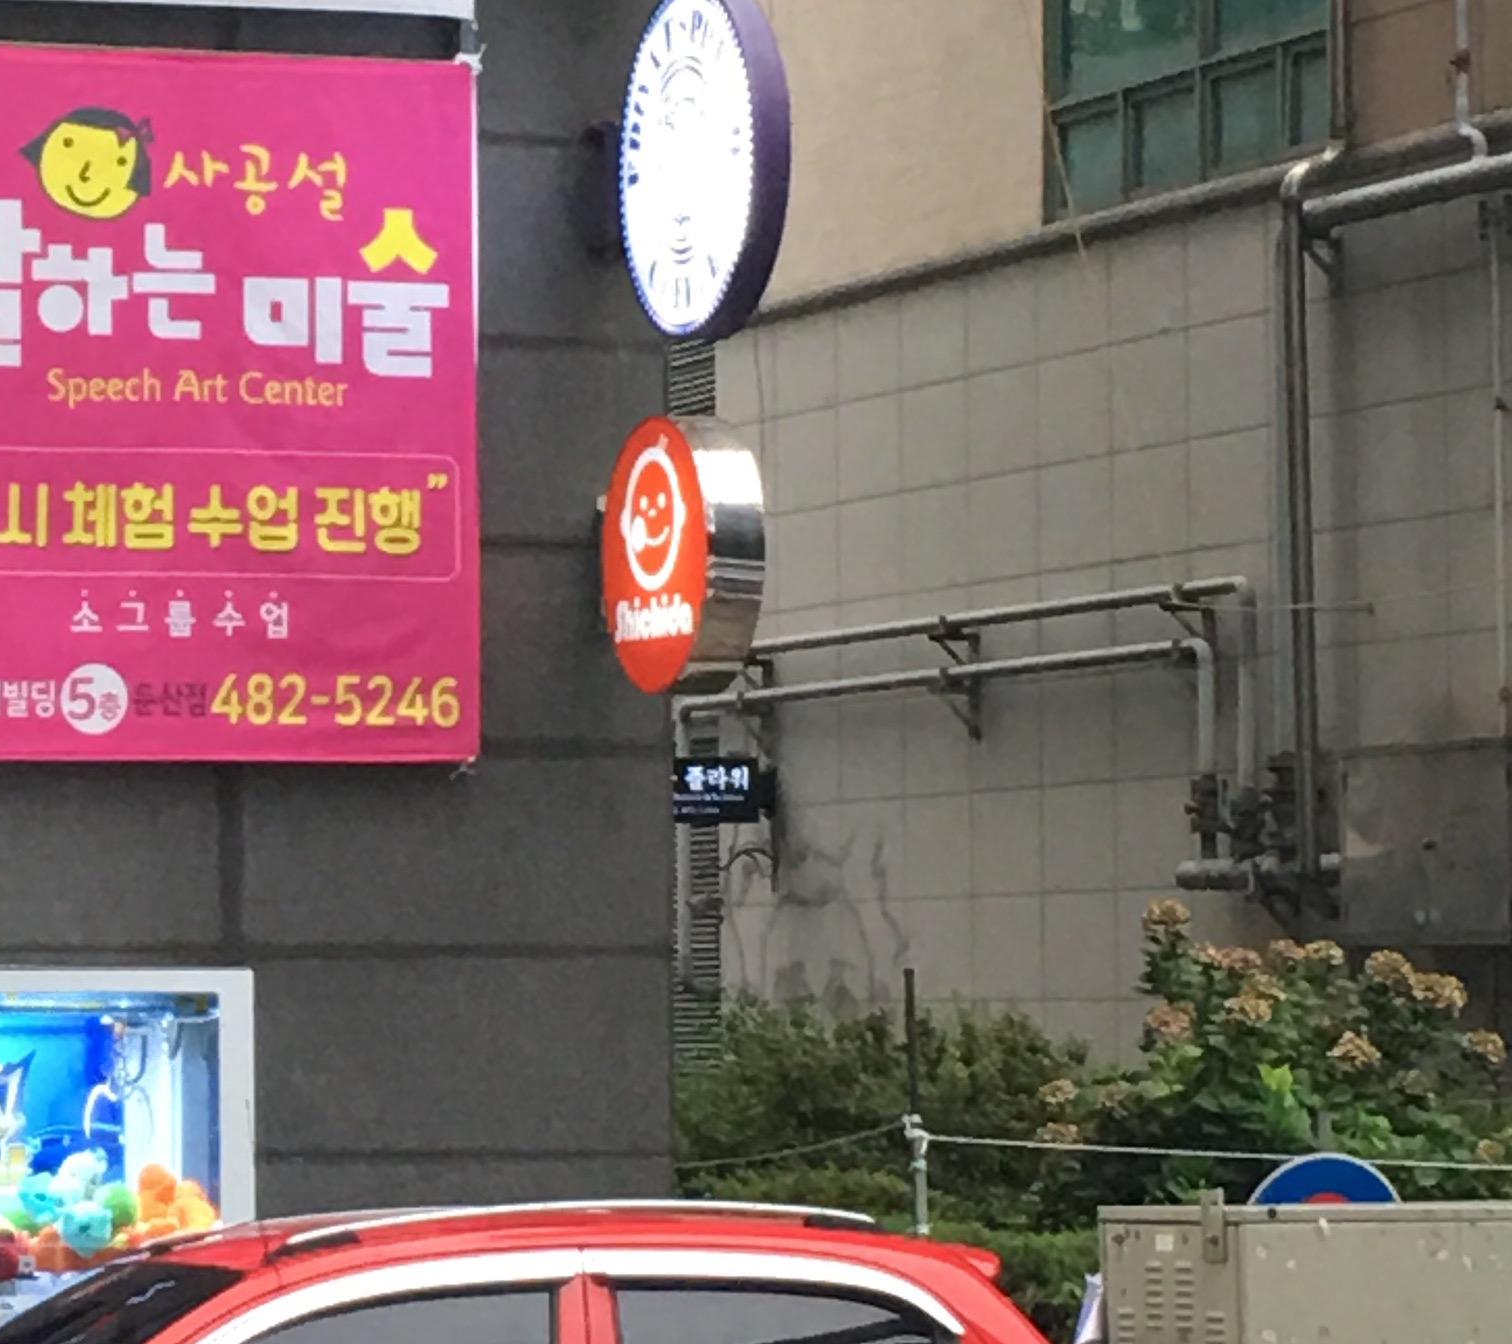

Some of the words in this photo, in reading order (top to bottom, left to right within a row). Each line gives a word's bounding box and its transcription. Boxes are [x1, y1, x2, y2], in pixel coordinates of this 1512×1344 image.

[163, 143, 347, 221] 사공설
[242, 208, 450, 378] 미술
[45, 368, 161, 409] Speech
[173, 369, 228, 404] Art
[239, 371, 347, 408] Center
[62, 481, 174, 551] 체험
[187, 483, 299, 552] 수업
[133, 681, 208, 717] 둔산점
[210, 672, 460, 729] 482-5246
